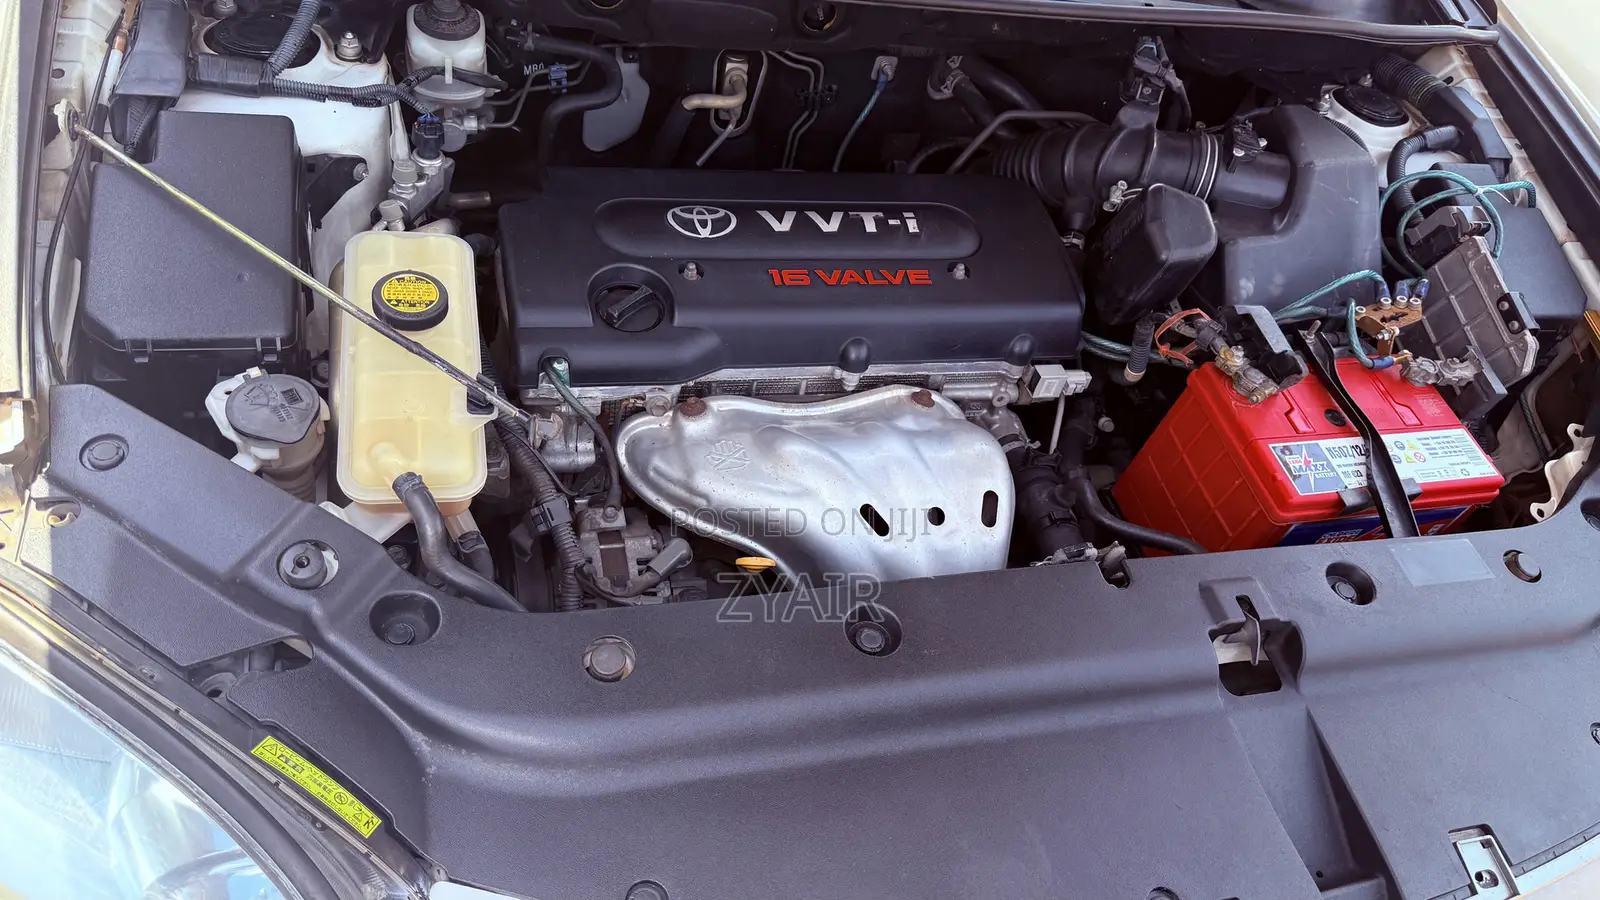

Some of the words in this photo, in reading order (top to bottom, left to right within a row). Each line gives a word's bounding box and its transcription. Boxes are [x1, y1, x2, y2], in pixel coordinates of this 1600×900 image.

[757, 210, 919, 232] VVT-i
[768, 269, 810, 285] 16
[814, 269, 932, 285] VALVE
[1291, 463, 1328, 473] MAXX
